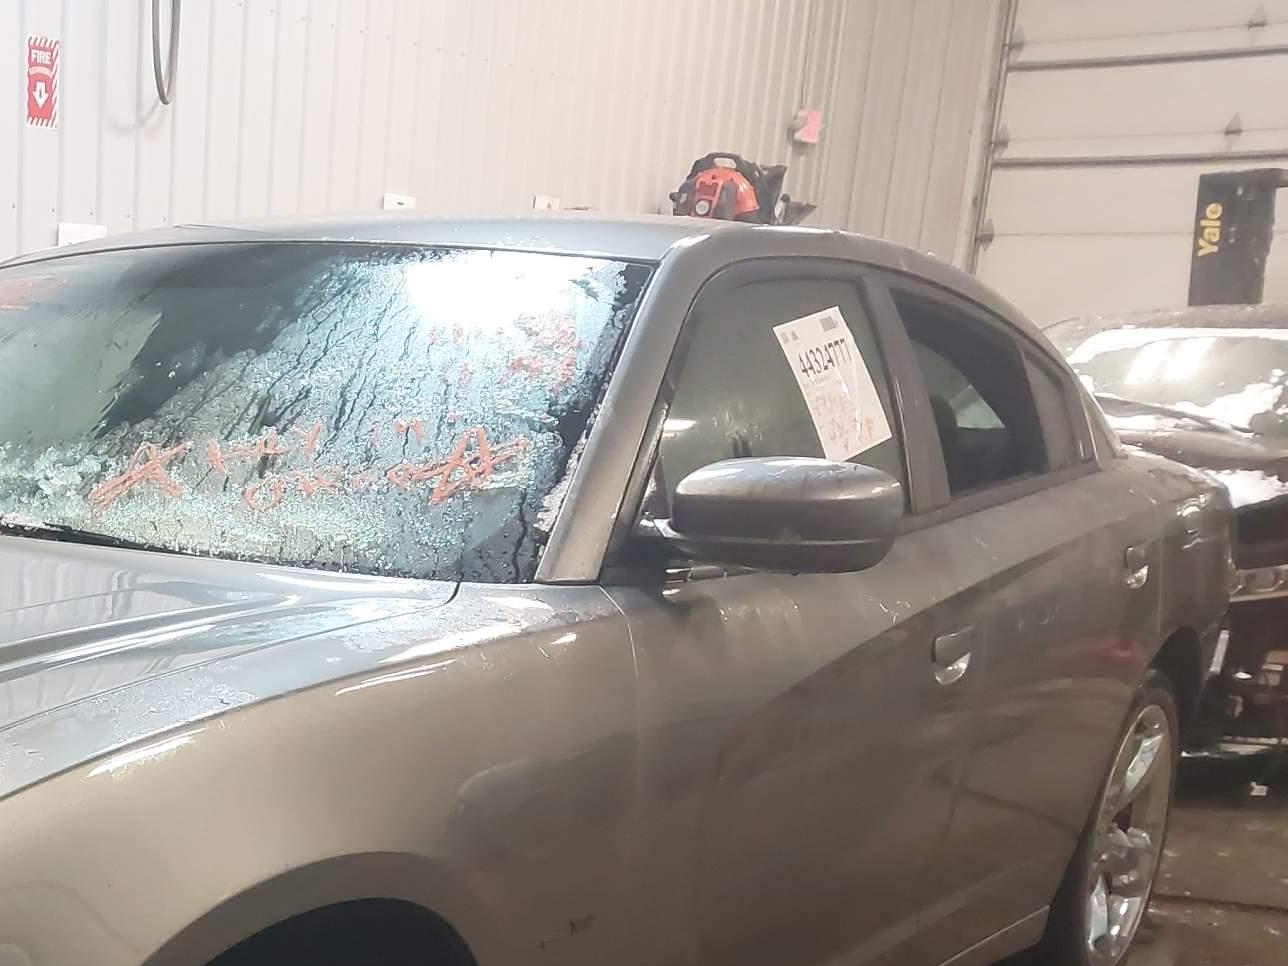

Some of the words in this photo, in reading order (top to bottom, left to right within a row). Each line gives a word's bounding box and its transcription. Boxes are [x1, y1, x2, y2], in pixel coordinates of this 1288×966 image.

[31, 49, 52, 64] FIRE
[1197, 202, 1223, 257] Yale
[798, 338, 853, 378] 44324777
